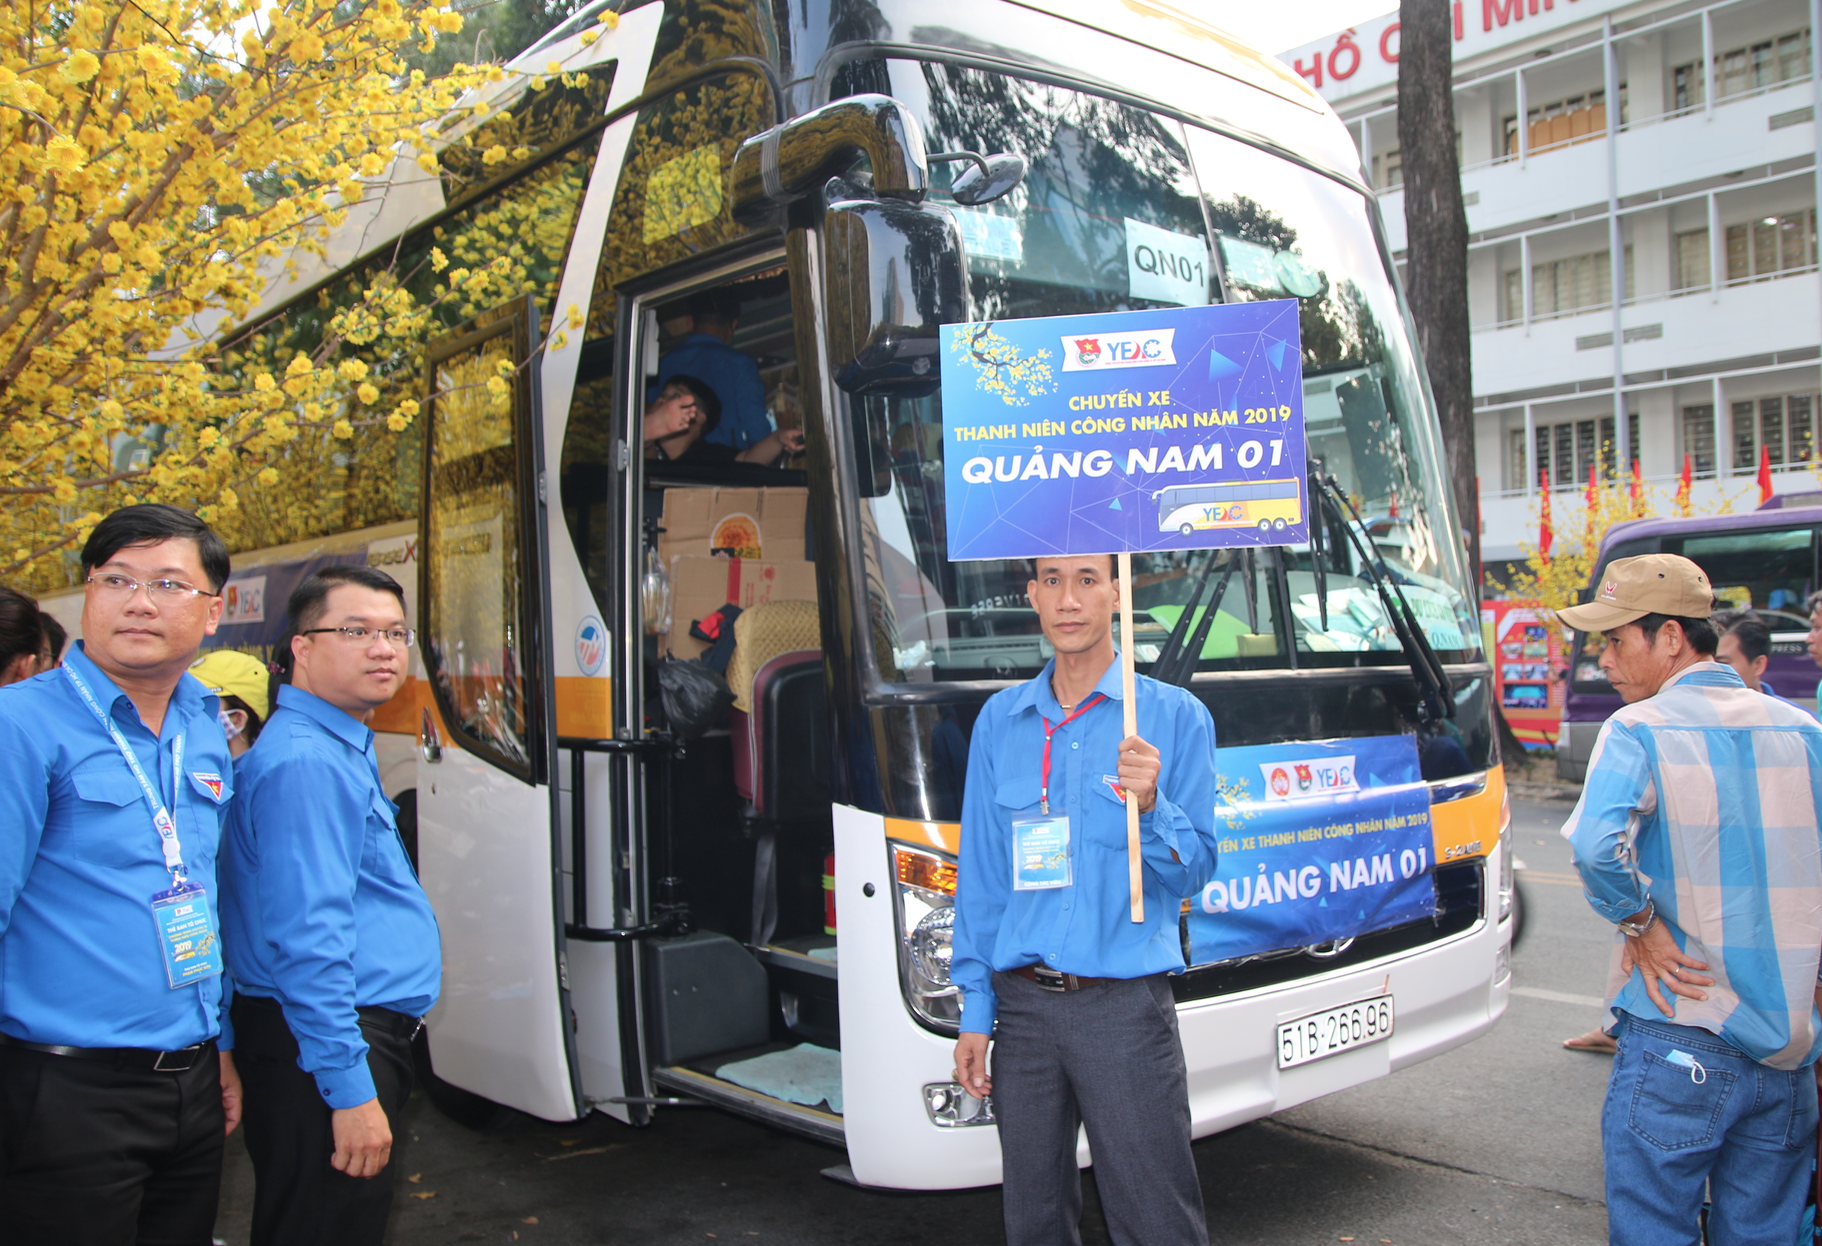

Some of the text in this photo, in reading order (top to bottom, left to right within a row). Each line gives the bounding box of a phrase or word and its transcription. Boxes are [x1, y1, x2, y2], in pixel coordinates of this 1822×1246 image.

[1134, 245, 1204, 288] QN01
[1069, 388, 1171, 411] CHUYẾN XE
[954, 406, 1292, 441] THANH NIÊN CÔNG NHÂN NĂM 2019
[961, 439, 1283, 484] QUẢNG NAM 01
[1241, 837, 1256, 851] XE
[1258, 831, 1296, 848] THANH
[1297, 826, 1323, 843] NIÊN
[1324, 823, 1354, 839] CÔNG
[1355, 817, 1384, 834] NHÂN
[1384, 815, 1407, 830] NĂM
[1407, 812, 1428, 826] 2019
[1201, 847, 1427, 914] QUẢNG NAM 01
